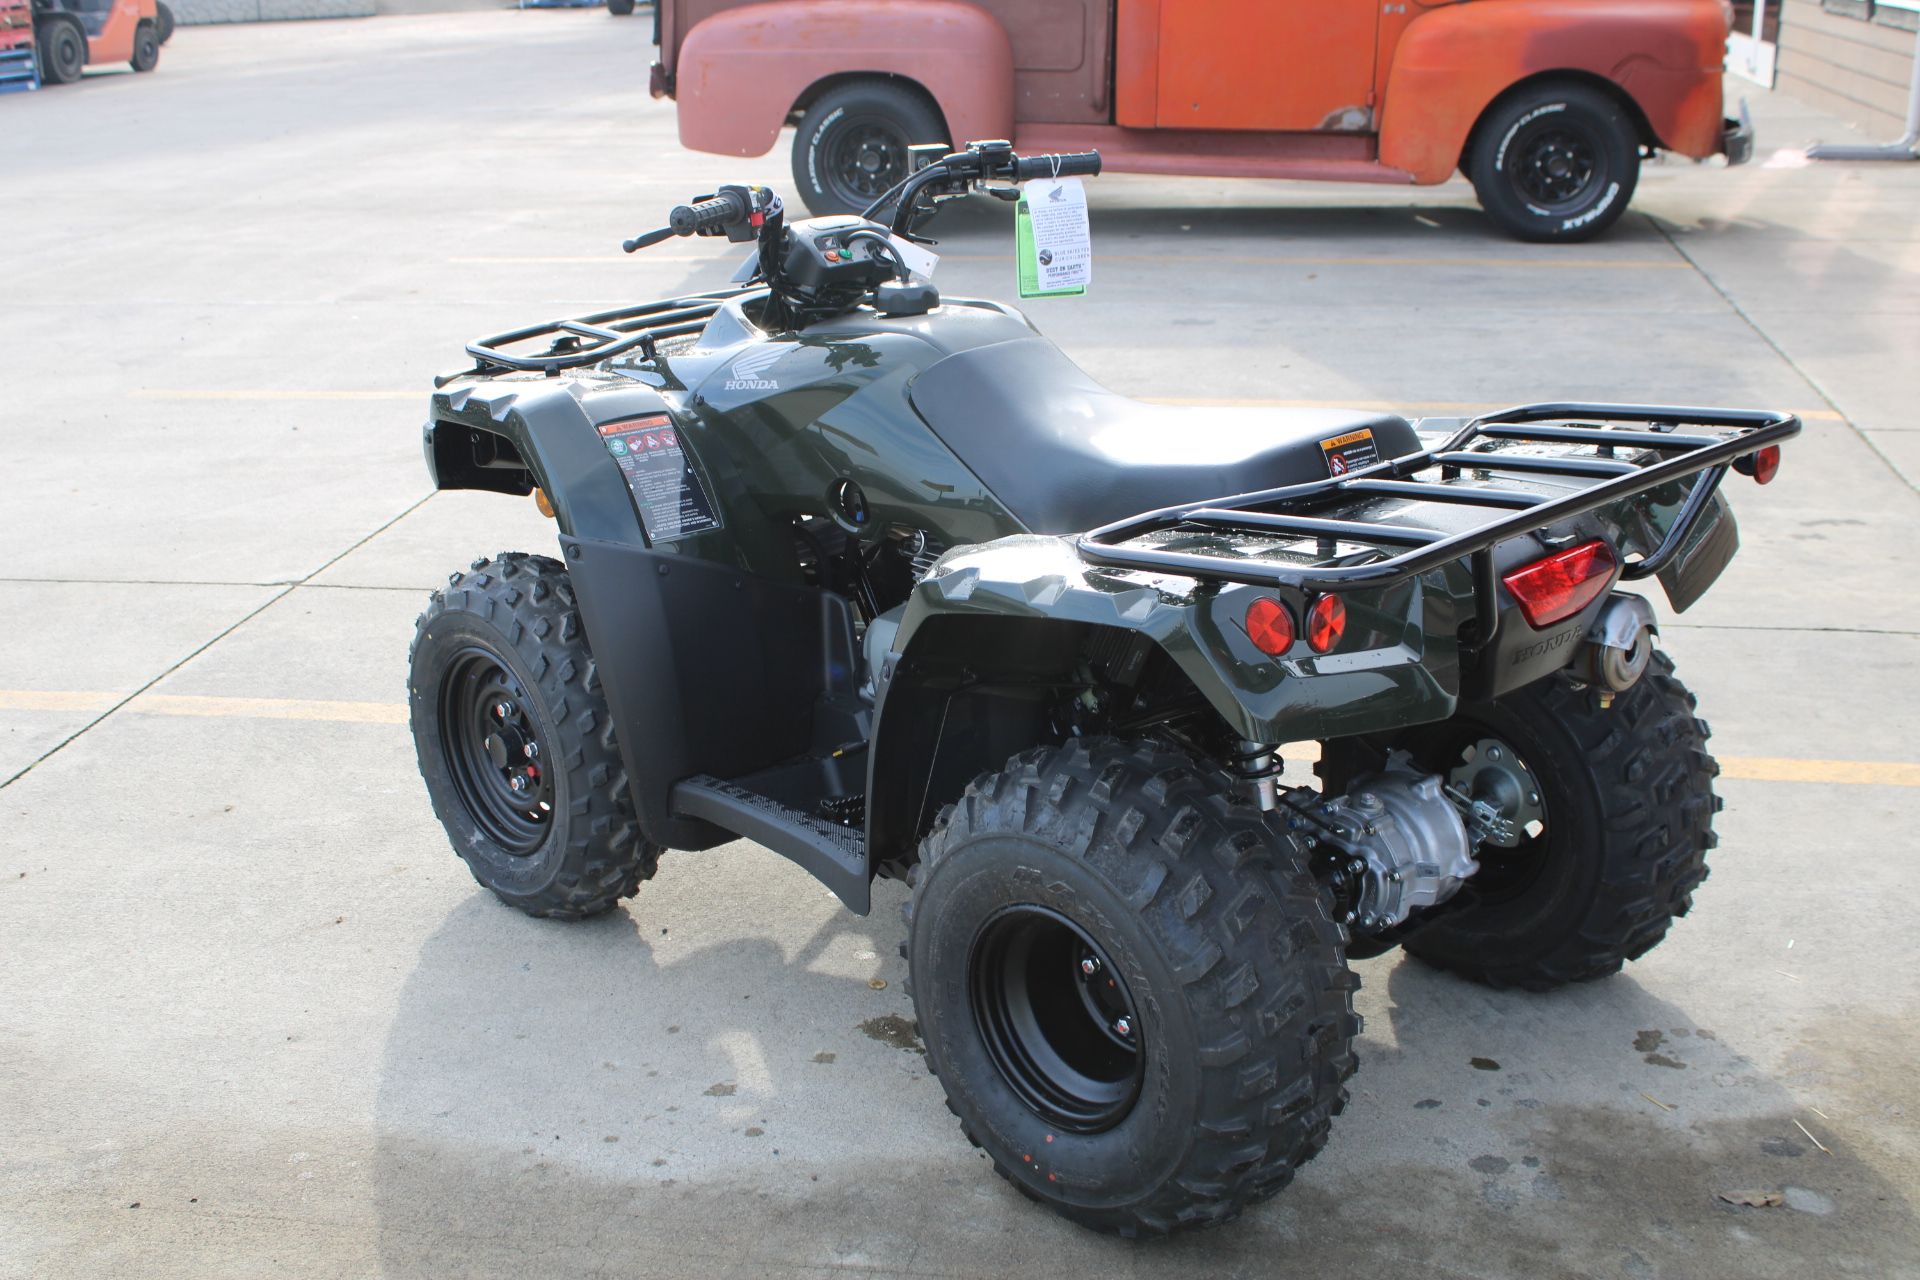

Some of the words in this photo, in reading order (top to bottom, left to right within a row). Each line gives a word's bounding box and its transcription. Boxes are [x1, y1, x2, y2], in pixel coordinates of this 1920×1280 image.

[811, 107, 845, 147] CLASSIC
[724, 379, 779, 391] HONDA
[621, 420, 654, 431] WARNING
[1336, 432, 1364, 445] WARNING
[1511, 624, 1584, 666] HONDA
